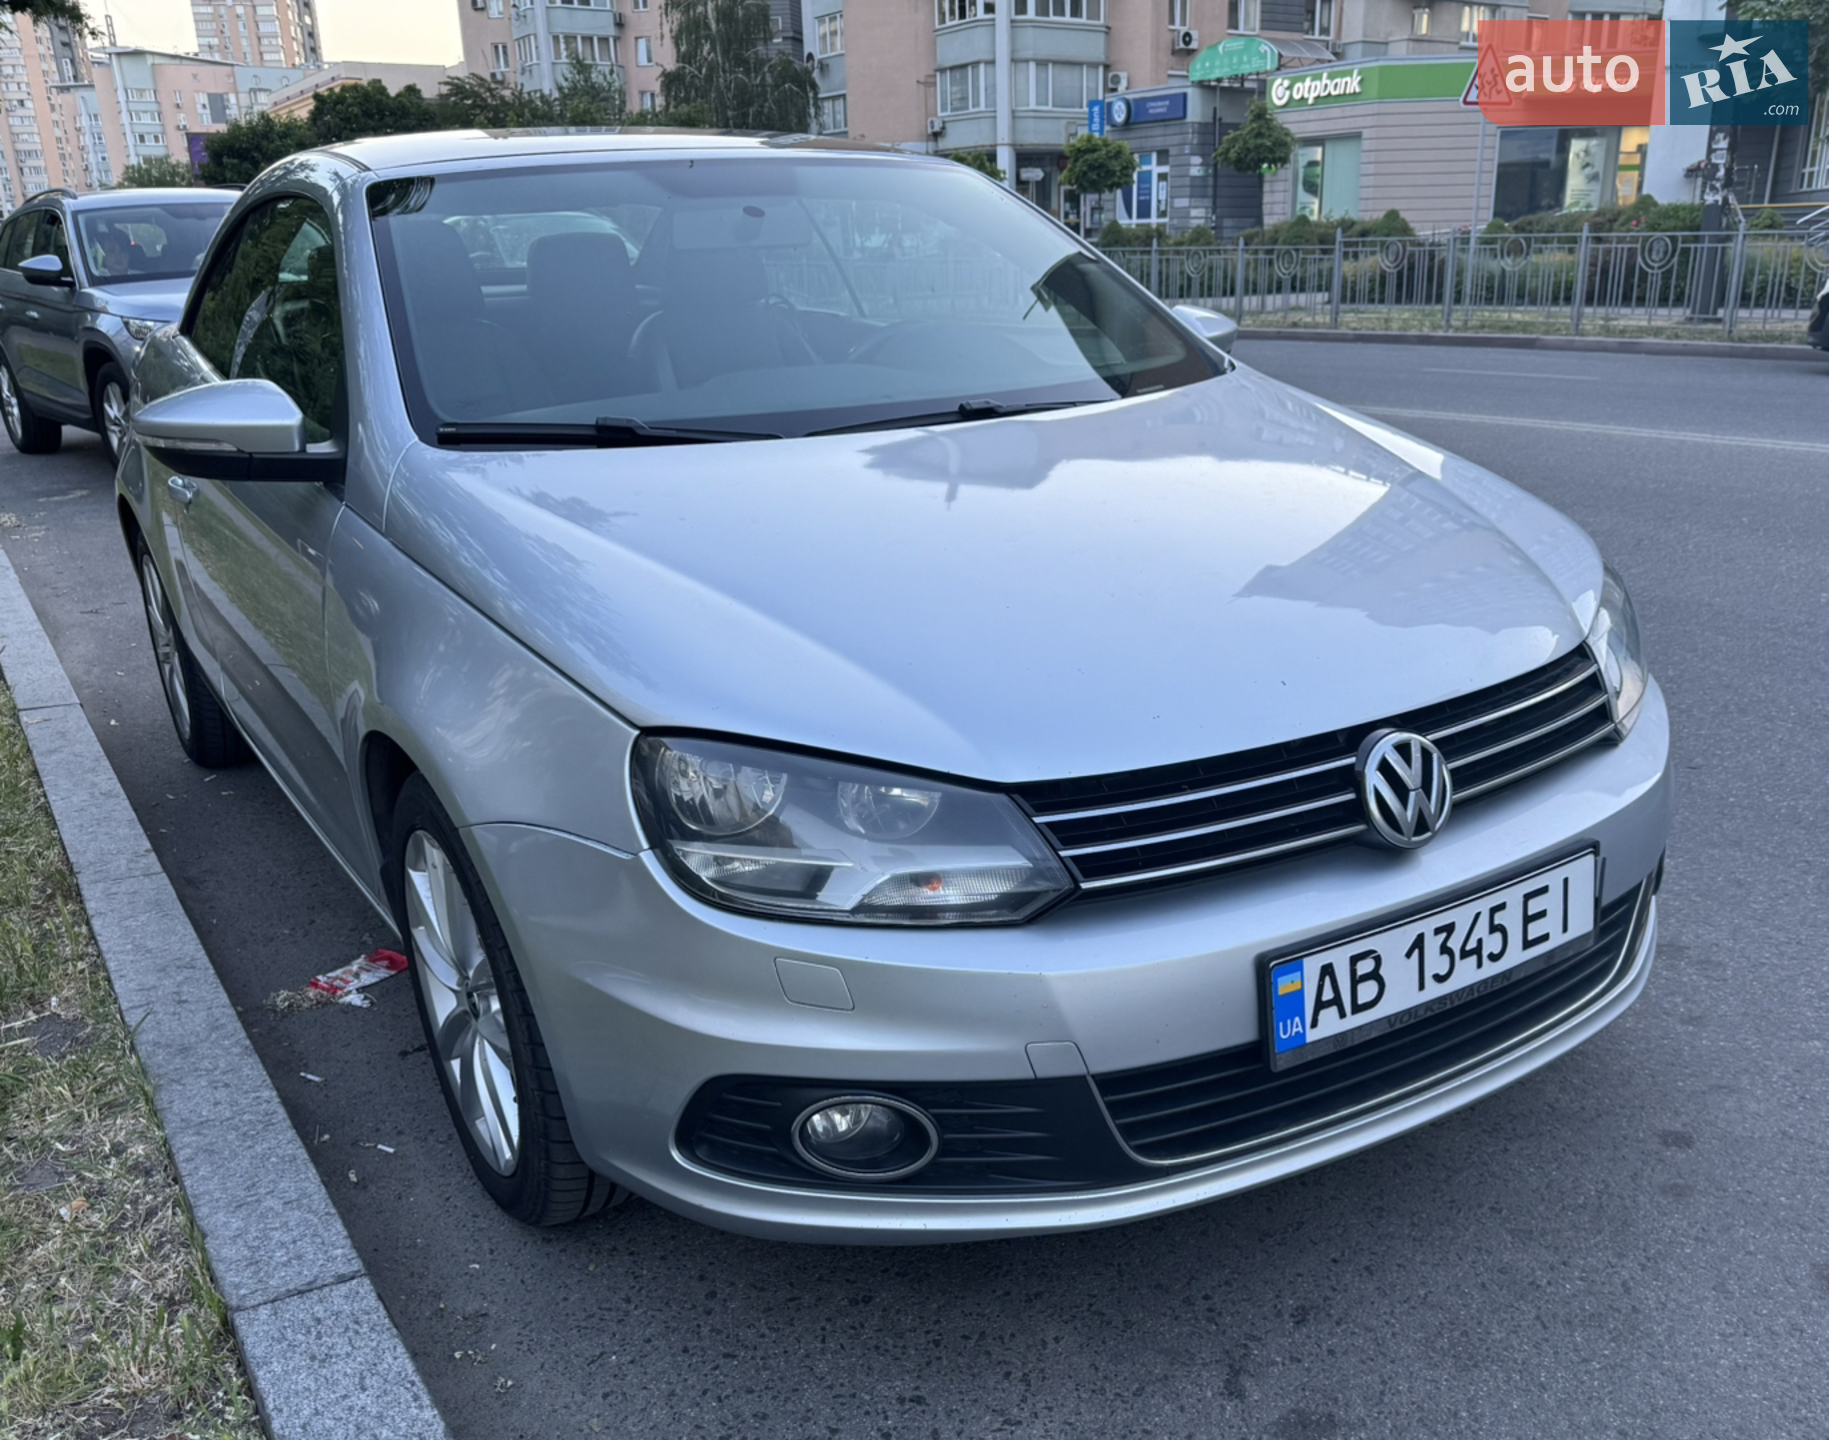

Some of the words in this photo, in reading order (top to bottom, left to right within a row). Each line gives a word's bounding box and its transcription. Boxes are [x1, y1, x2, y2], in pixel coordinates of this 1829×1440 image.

[1292, 69, 1362, 105] otpbank
[1091, 105, 1100, 131] Bank
[1310, 949, 1386, 1030] AB
[1405, 901, 1509, 992] 1345
[1522, 876, 1569, 951] EI
[1386, 970, 1513, 1029] VOLKSWAGEN
[1279, 1016, 1303, 1039] UA
